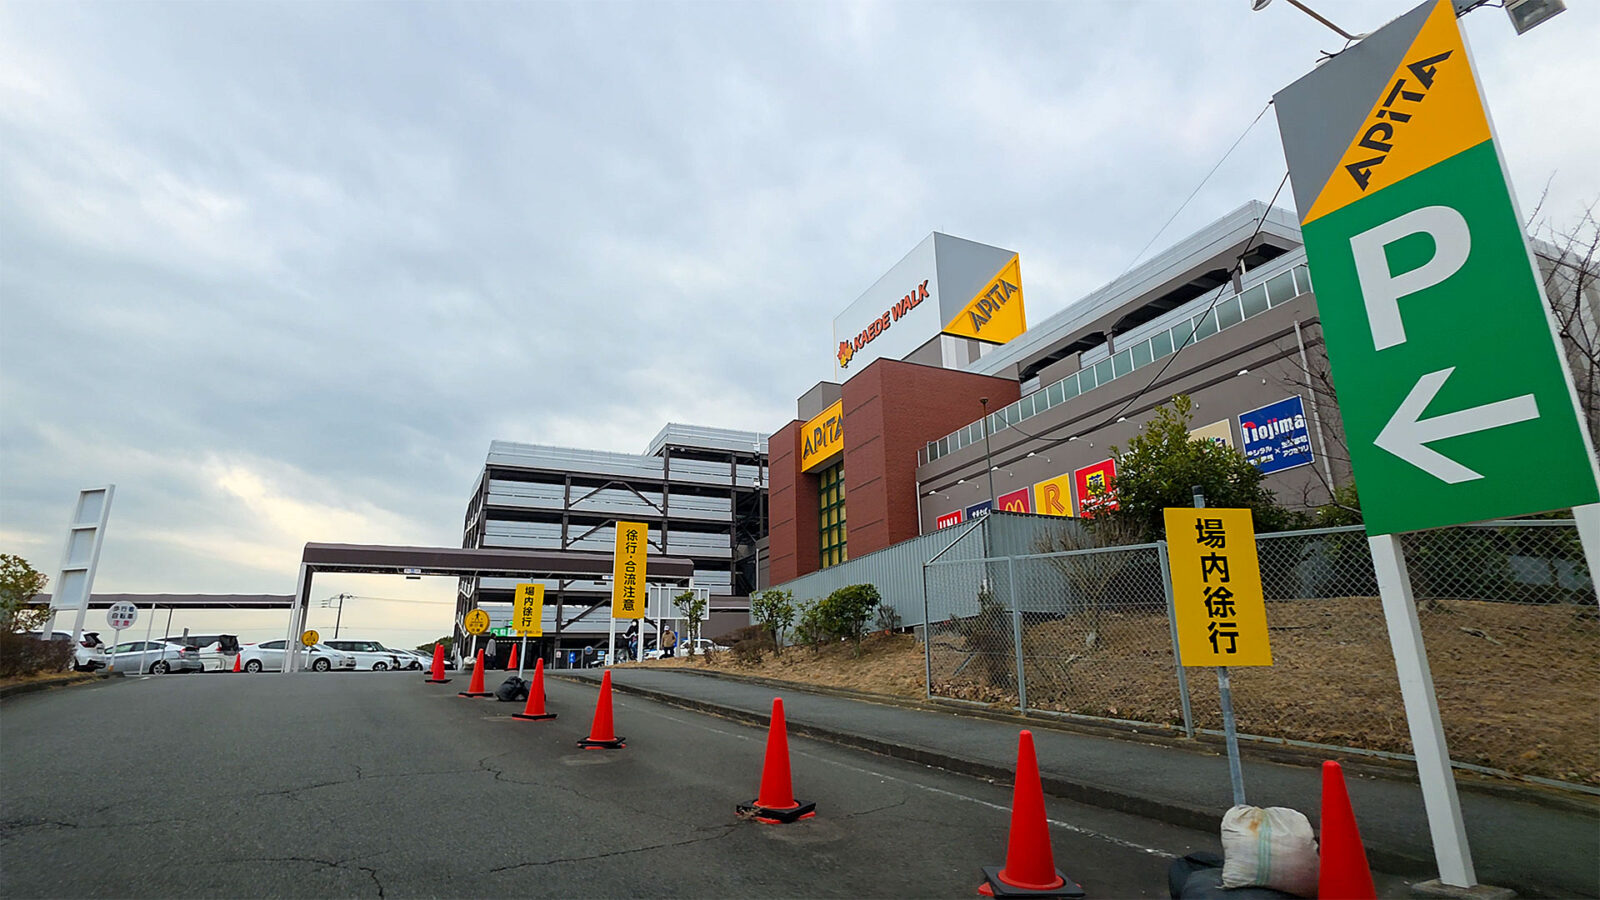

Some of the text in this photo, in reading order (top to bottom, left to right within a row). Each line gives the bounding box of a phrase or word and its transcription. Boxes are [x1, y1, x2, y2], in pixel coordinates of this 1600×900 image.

[853, 279, 930, 352] KAEDE WALK
[968, 278, 1018, 332] APITA
[1349, 205, 1472, 352] P
[521, 585, 535, 627] 場内徐行
[622, 528, 639, 611] 徐行・合流注意
[1195, 517, 1239, 654] 場内徐行
